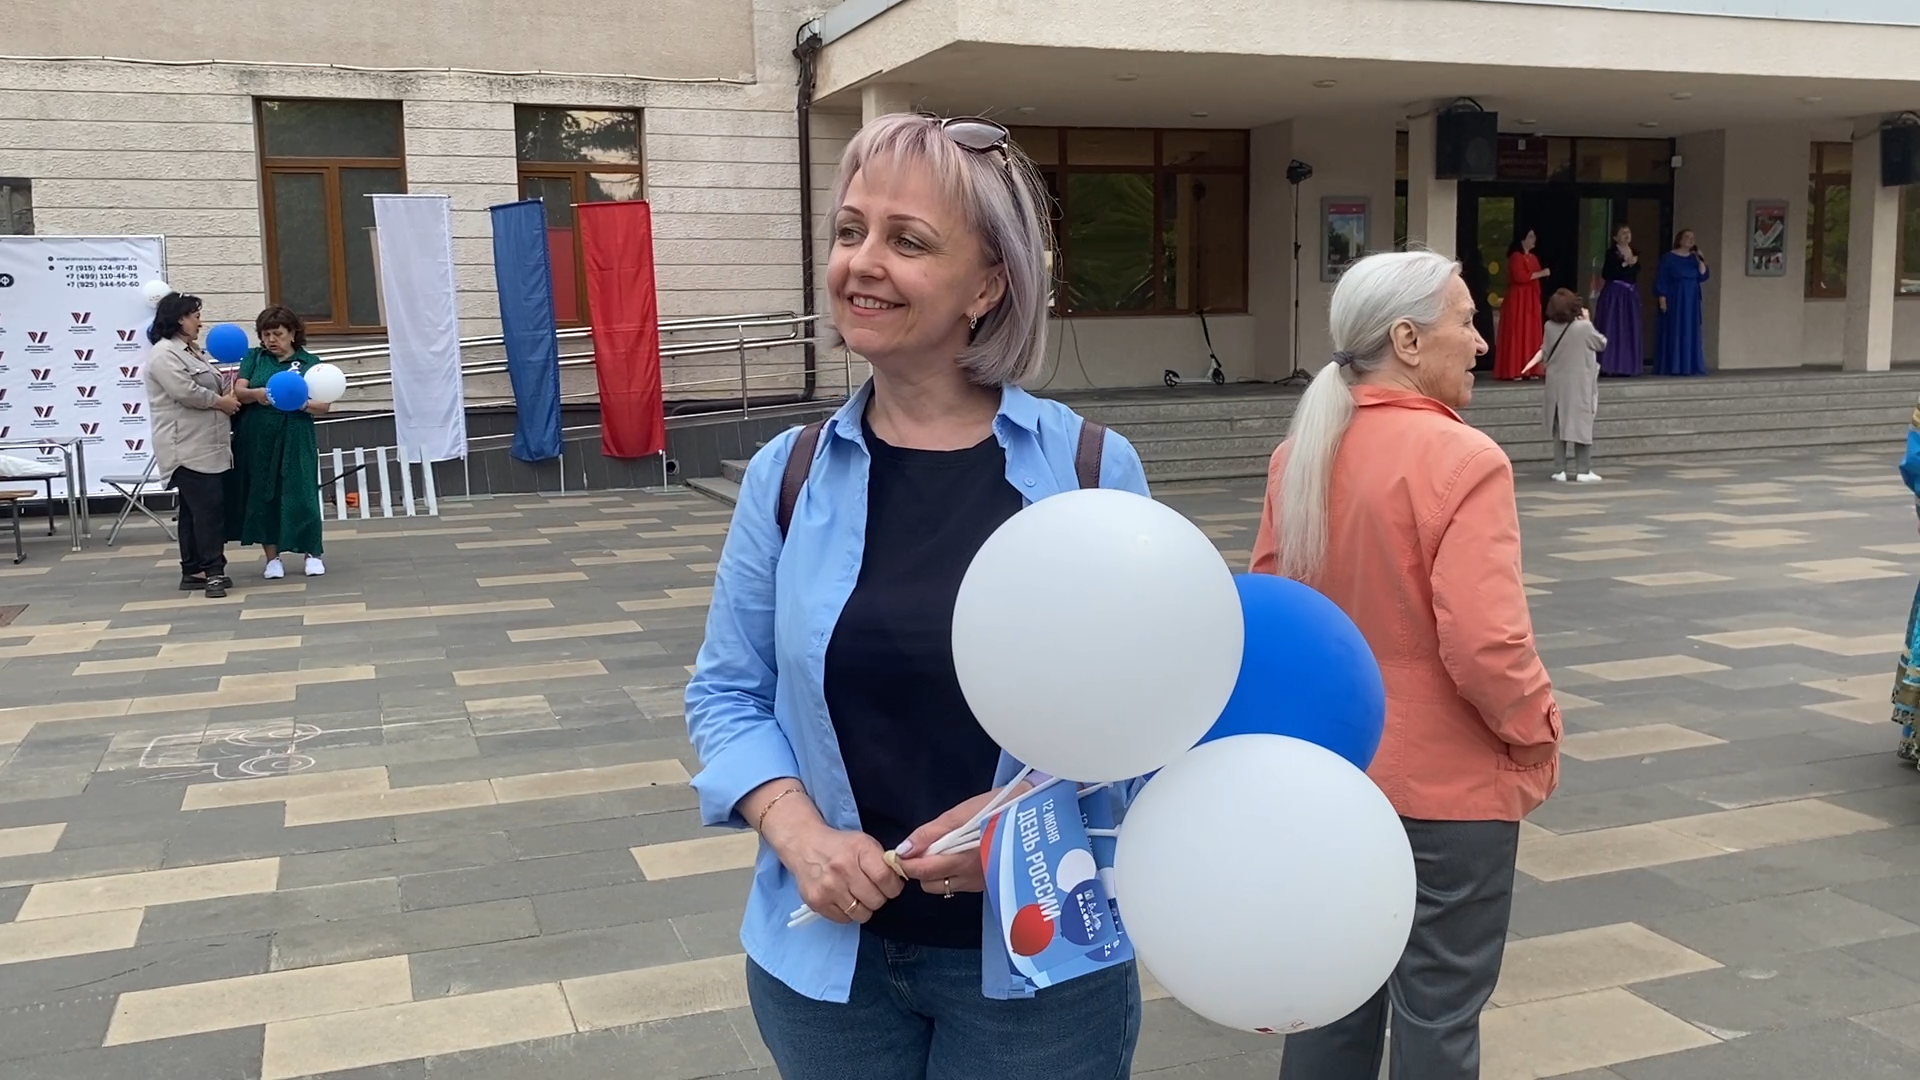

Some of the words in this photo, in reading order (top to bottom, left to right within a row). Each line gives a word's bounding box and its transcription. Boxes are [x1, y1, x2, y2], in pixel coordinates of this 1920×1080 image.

[1042, 798, 1054, 813] 12
[1016, 807, 1041, 852] ДЕНЬ
[1043, 811, 1061, 844] ИЮНЯ
[1026, 851, 1062, 922] РОССИИ
